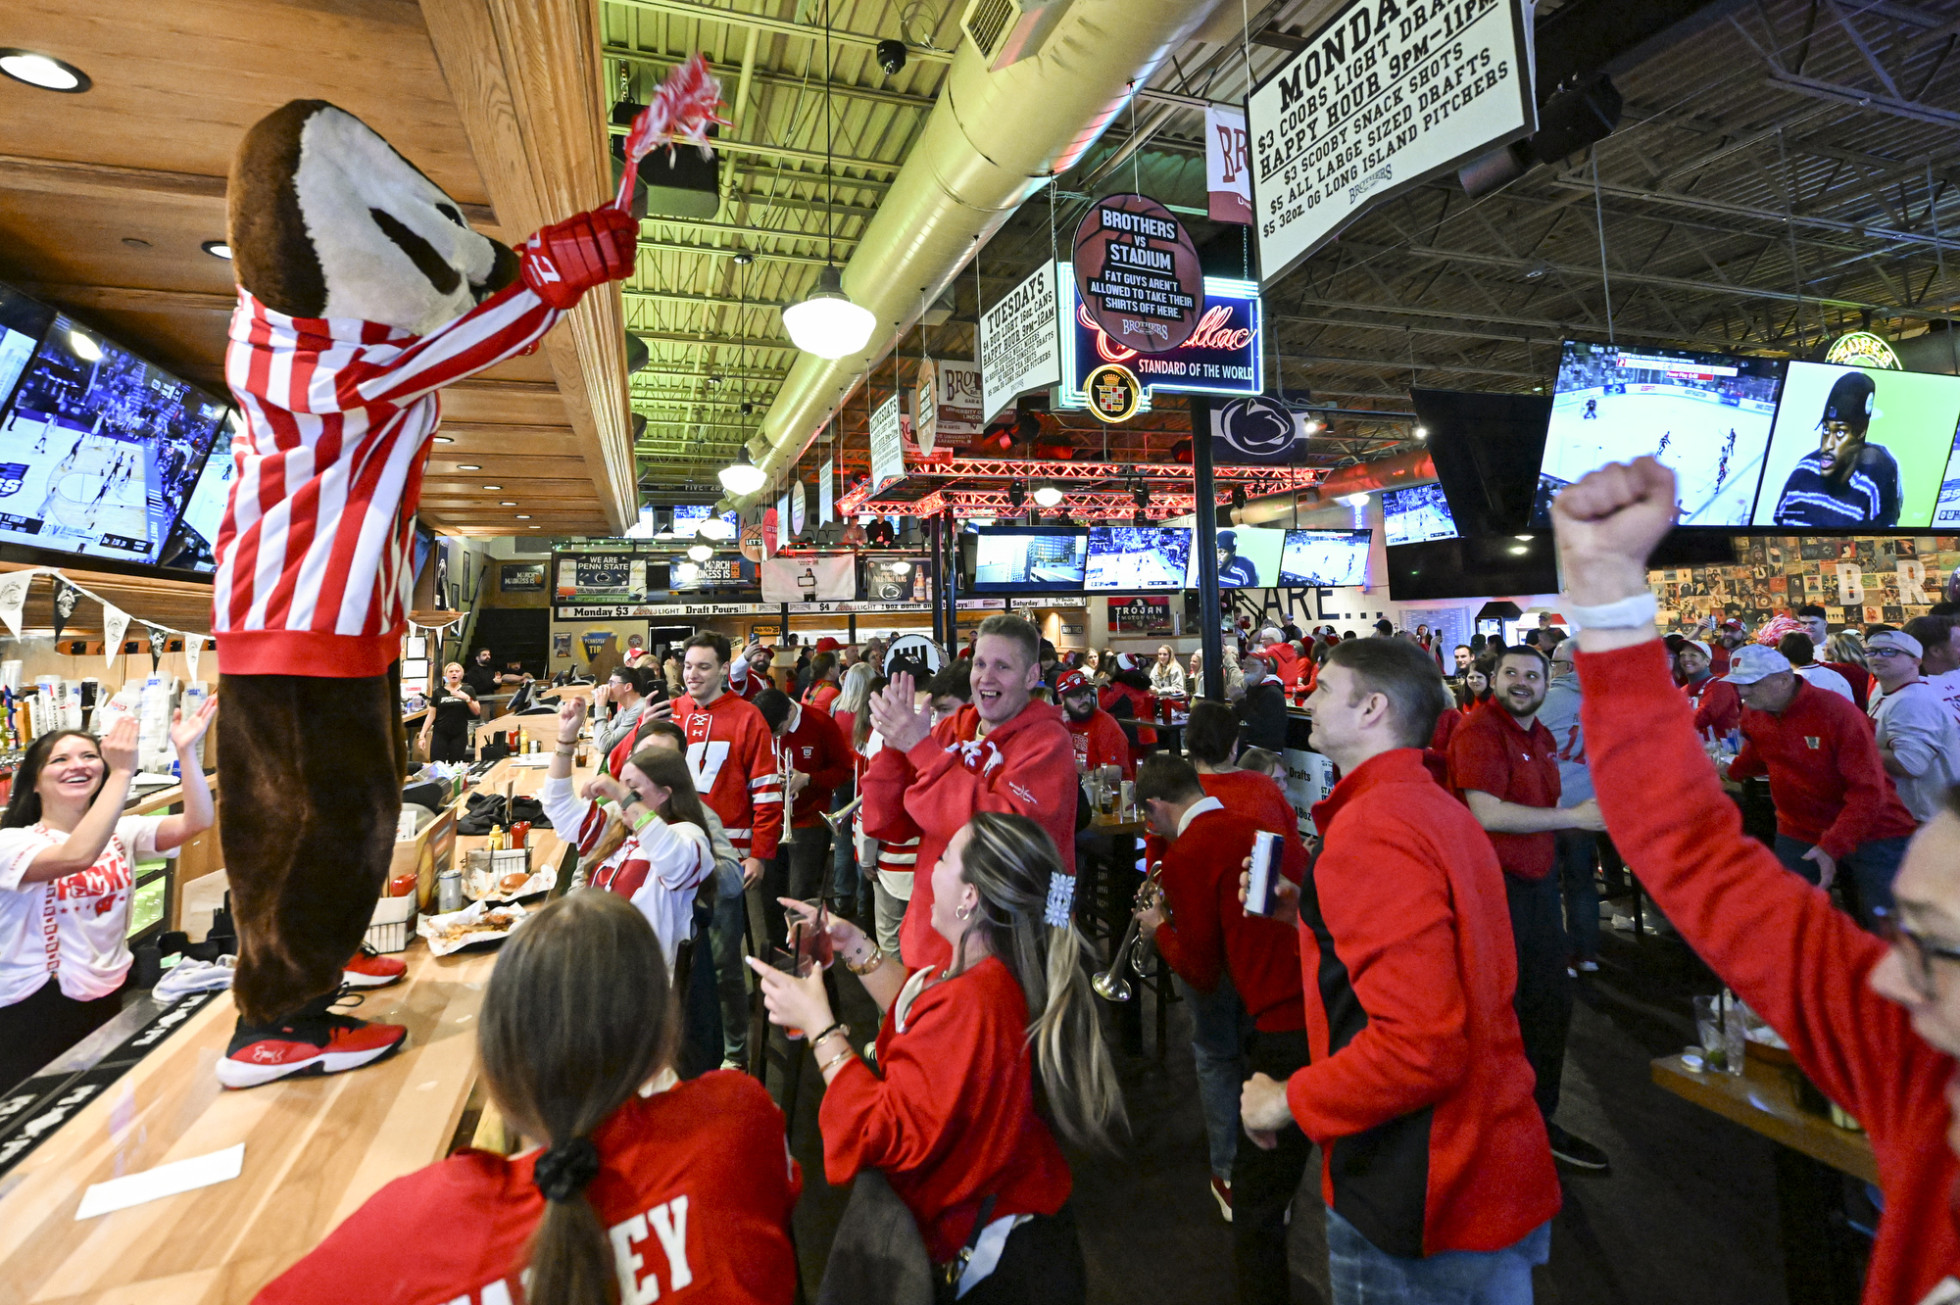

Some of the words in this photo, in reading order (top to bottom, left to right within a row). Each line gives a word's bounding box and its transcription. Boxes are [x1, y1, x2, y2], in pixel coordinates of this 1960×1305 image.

[1278, 0, 1416, 115] MONDA
[1258, 129, 1274, 155] $3
[1280, 86, 1328, 138] COORS
[1334, 32, 1391, 96] LIGHT
[1399, 0, 1458, 43] DRA
[1260, 117, 1318, 179] HAPPY
[1326, 71, 1381, 130] HOUR
[1284, 165, 1298, 185] $3
[1301, 127, 1347, 173] SCOOBY
[1353, 86, 1404, 135] SNACK
[1409, 42, 1463, 94] SHOTS
[1270, 195, 1284, 215] $5
[1288, 176, 1313, 204] ALL
[1317, 139, 1362, 183] LARGE
[1367, 103, 1413, 148] SIZED
[1418, 47, 1491, 113] DRAFTS
[1263, 220, 1276, 238] $5
[1307, 190, 1321, 209] OG
[1325, 165, 1358, 198] LONG
[1362, 124, 1418, 174] ISLAND
[1423, 60, 1508, 133] PITCHERS
[1347, 163, 1393, 205] BROTHERS
[1102, 209, 1176, 240] BROTHERS
[1134, 235, 1147, 248] VS
[1110, 244, 1172, 270] STADIUM
[1105, 270, 1122, 283] FAT
[1124, 273, 1148, 287] GUYS
[1148, 277, 1178, 292] AREN'T
[987, 271, 1044, 334] TUESDAYS
[1035, 290, 1053, 313] CANS
[1090, 281, 1131, 297] ALLOWED
[1132, 287, 1145, 300] TO
[1145, 290, 1168, 304] TAKE
[1168, 293, 1193, 308] THEIR
[1105, 296, 1138, 312] SHIRTS
[1139, 303, 1156, 315] OFF
[1157, 306, 1182, 319] HERE.
[1121, 319, 1169, 341] BROTHERS
[1139, 359, 1186, 376] STANDARD
[1189, 363, 1201, 376] OF
[1203, 364, 1220, 378] THE
[1222, 366, 1254, 380] WORLD
[578, 562, 601, 570] PENN
[603, 562, 629, 570] STATE
[704, 560, 731, 570] MARCH
[574, 606, 613, 618] Monday
[615, 605, 629, 617] $3
[658, 607, 680, 615] LIGHT
[685, 605, 710, 614] Draft
[712, 604, 748, 614] Pours!!!
[820, 603, 830, 611] $4
[1115, 607, 1162, 615] TROJAN
[1289, 767, 1311, 782] Drafts
